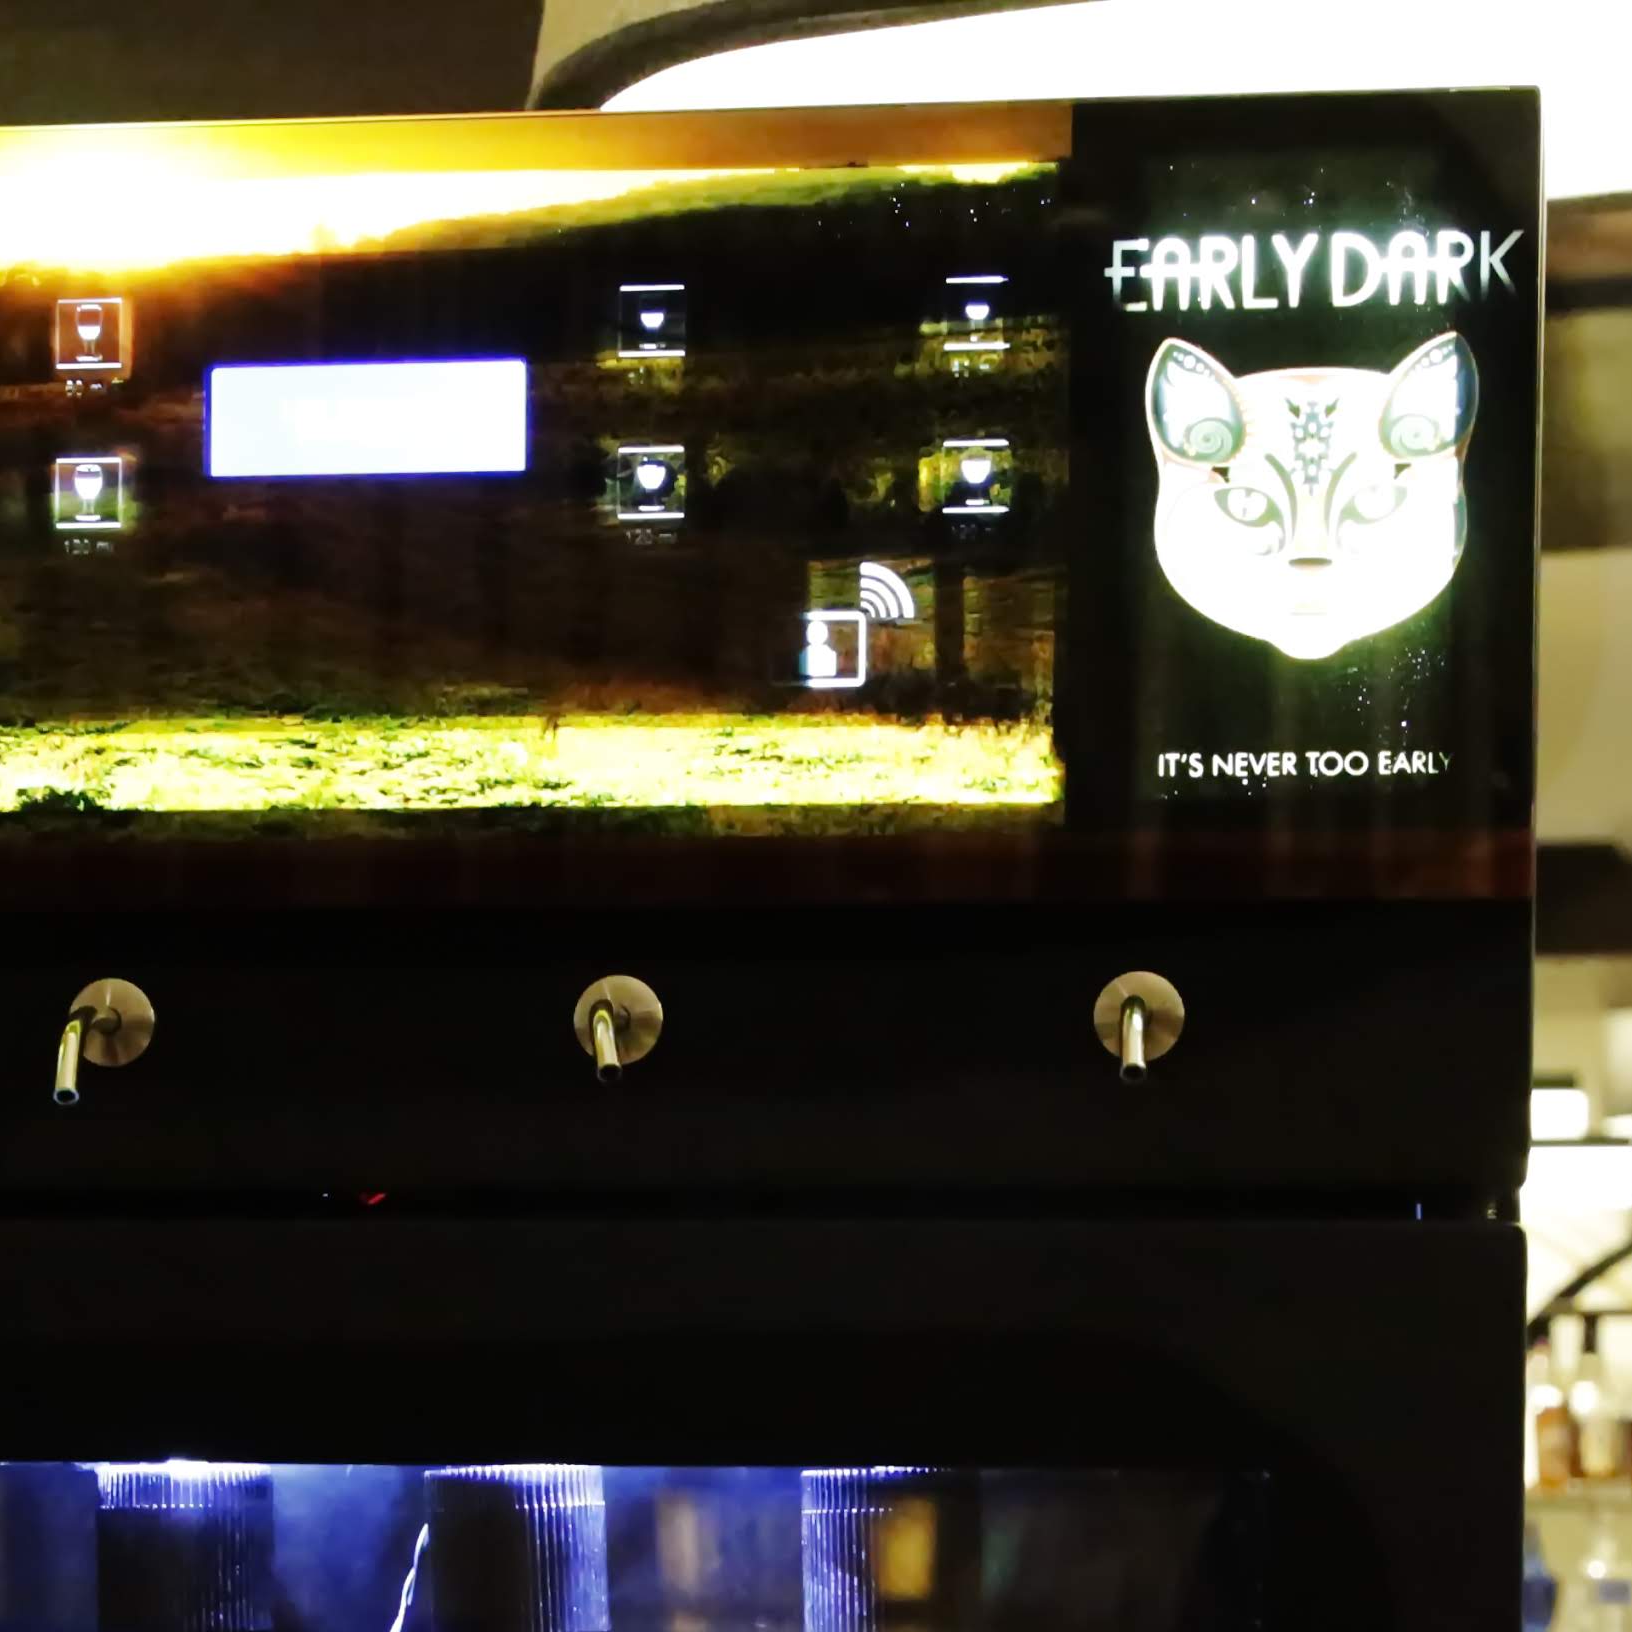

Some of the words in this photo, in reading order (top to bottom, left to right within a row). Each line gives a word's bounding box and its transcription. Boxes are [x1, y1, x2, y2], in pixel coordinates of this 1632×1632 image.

[1104, 232, 1320, 312] EARLY
[1330, 228, 1525, 307] DARK
[1157, 752, 1204, 778] IT'S
[1212, 752, 1298, 778] NEVER
[1305, 750, 1369, 778] TOO
[1377, 750, 1452, 776] EARLY
